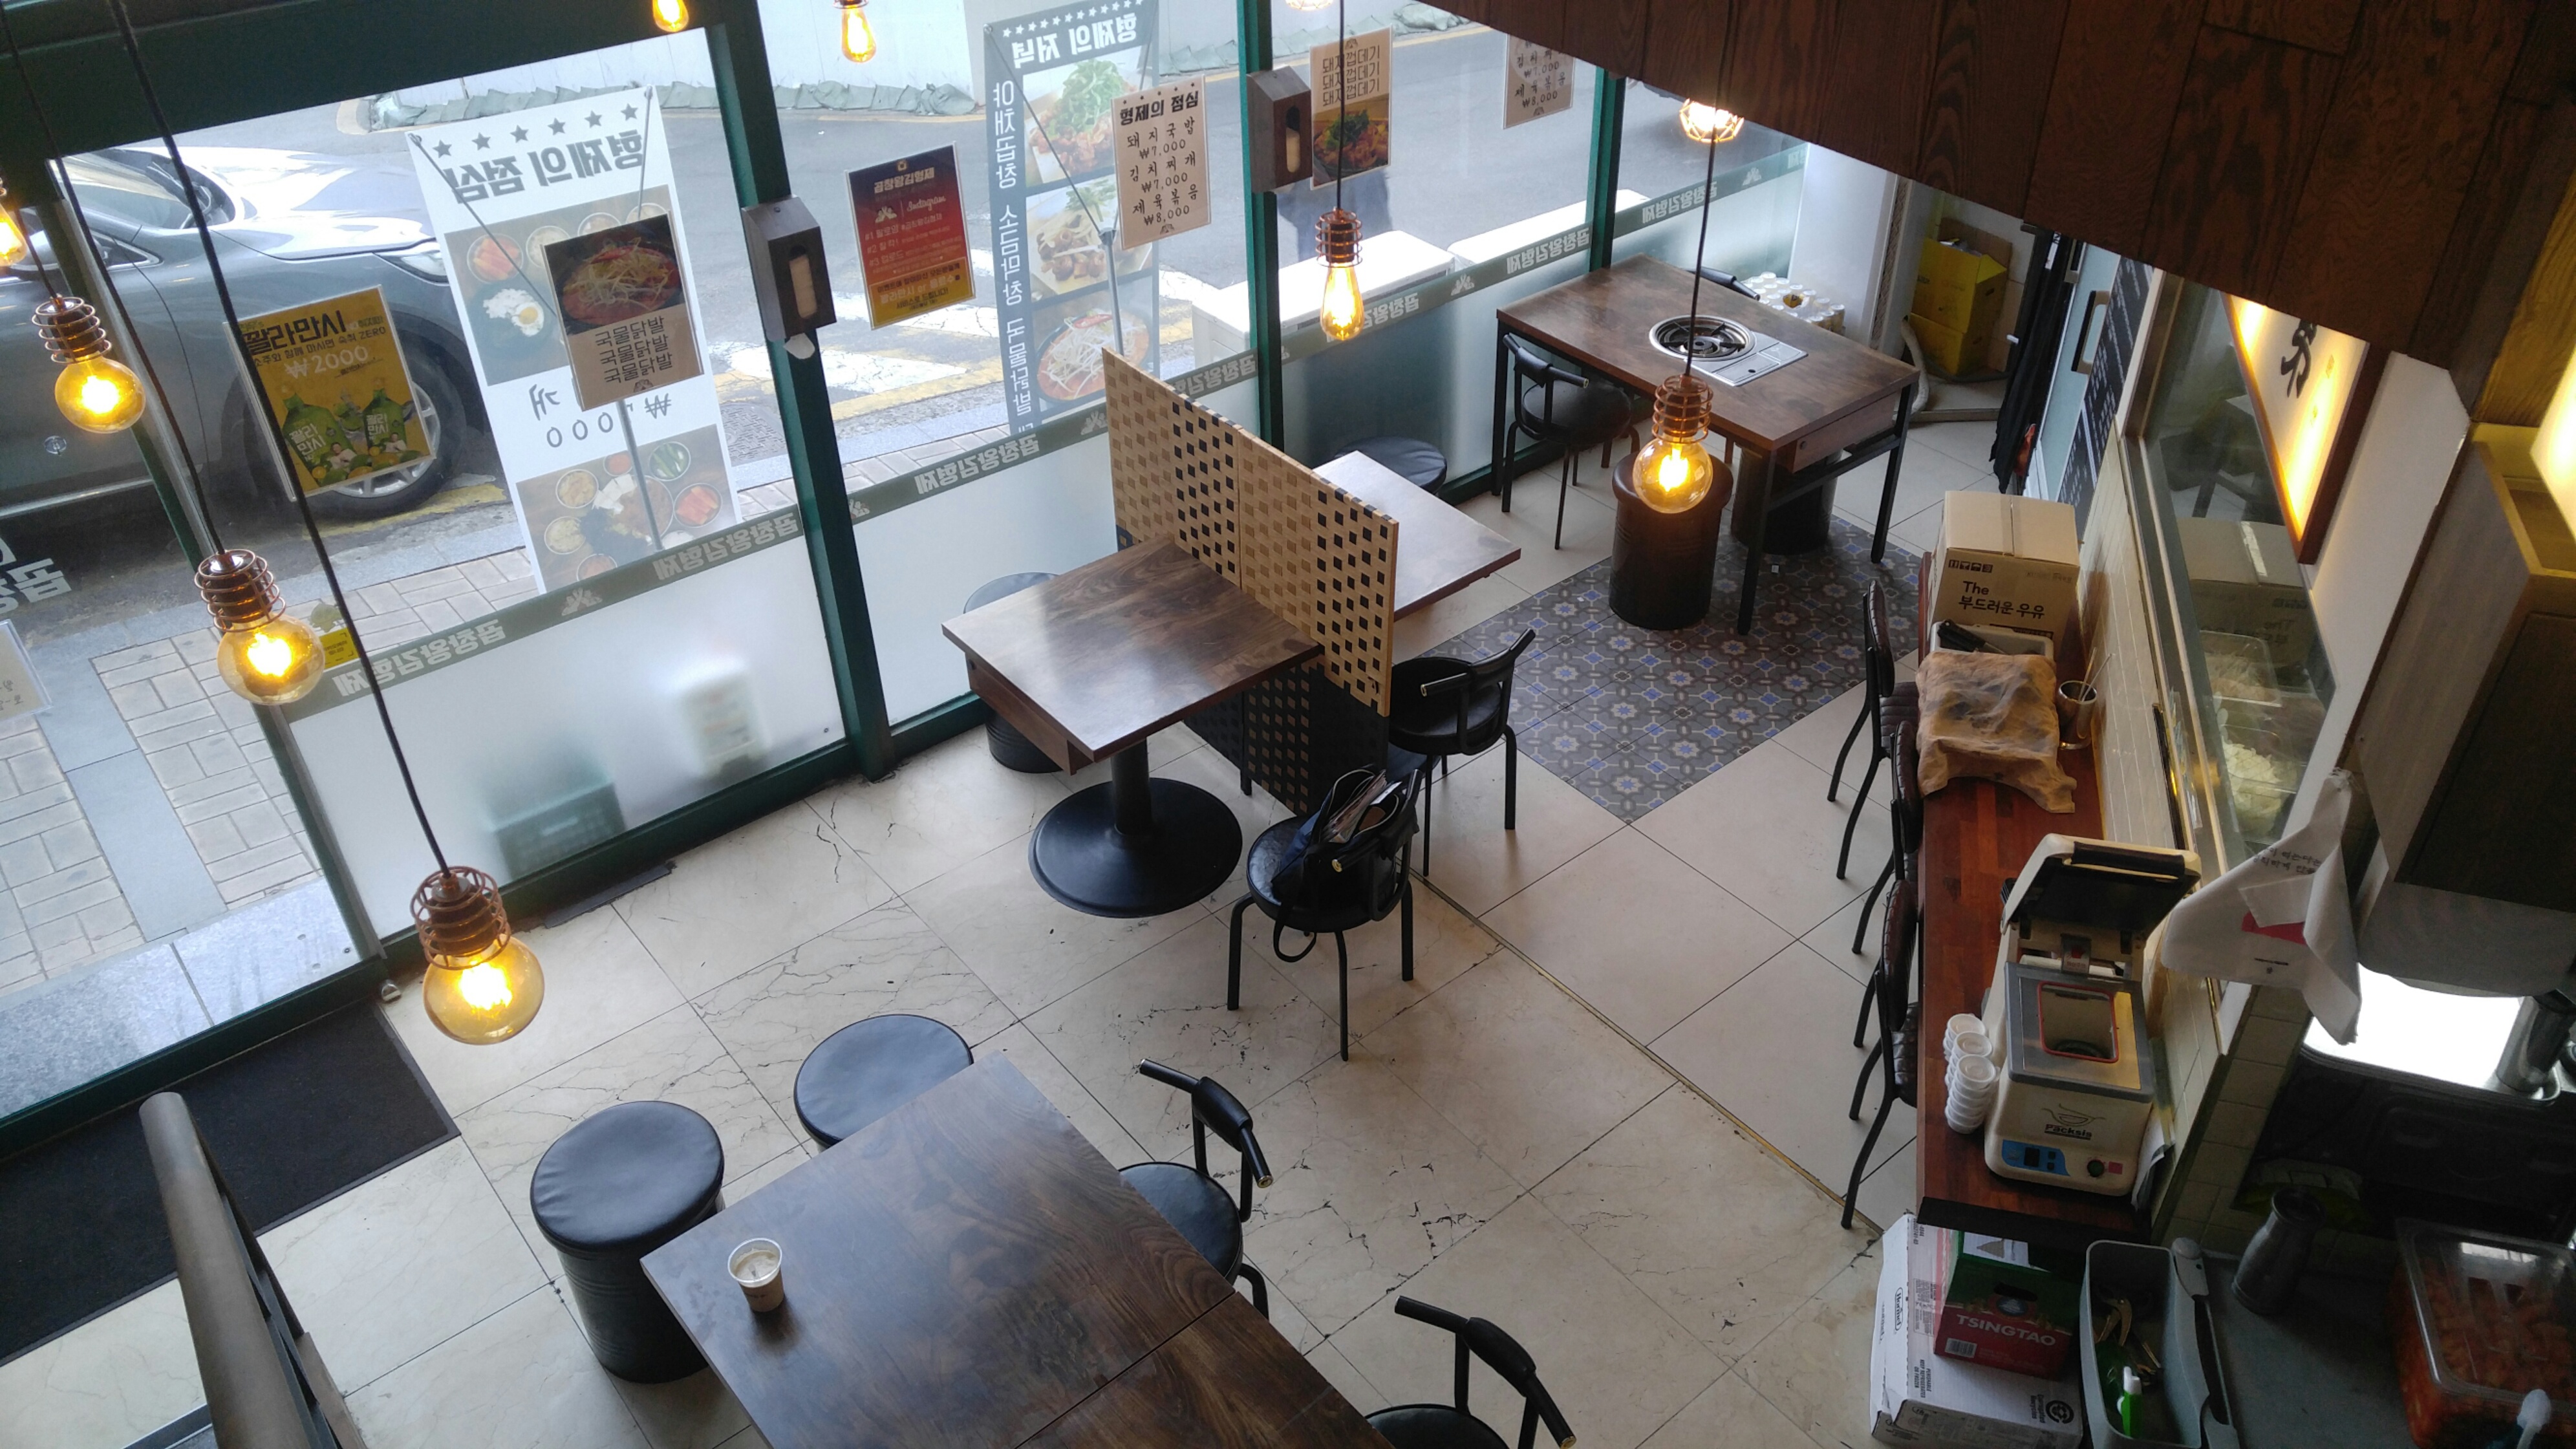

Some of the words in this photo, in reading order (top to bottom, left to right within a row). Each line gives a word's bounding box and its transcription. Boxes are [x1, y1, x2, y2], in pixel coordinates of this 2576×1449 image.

[1517, 50, 1565, 69] 김치찌
[1120, 100, 1165, 126] 형제의
[1170, 90, 1199, 113] 점심
[1139, 139, 1186, 159] ₩7,000
[1141, 172, 1188, 193] ₩7,000
[1144, 204, 1190, 226] ₩8,000
[360, 327, 387, 340] ZERO
[596, 316, 665, 347] 국물닭발
[599, 334, 669, 365] 국물닭발
[604, 352, 673, 383] 국물닭발
[1963, 581, 1990, 595] The
[1959, 596, 2013, 615] 부드러운
[2016, 603, 2045, 619] 우유
[2046, 1123, 2092, 1138] Packsis
[1957, 1314, 2056, 1346] TSINGTAO
